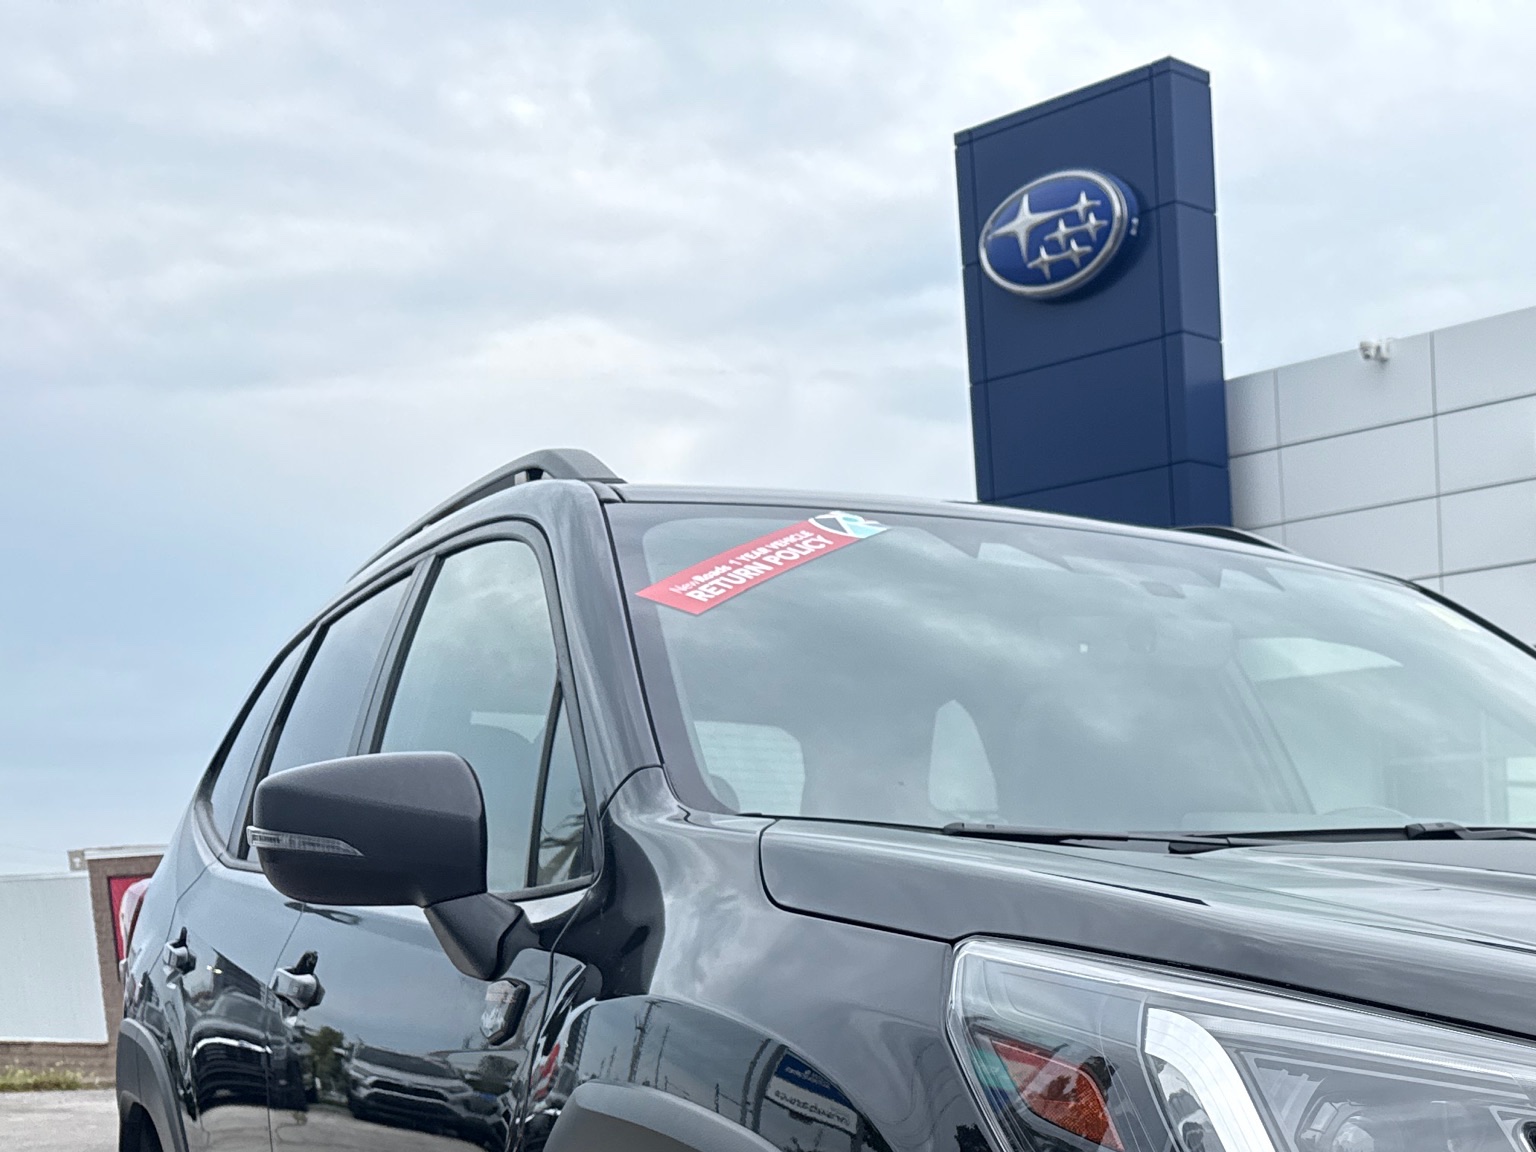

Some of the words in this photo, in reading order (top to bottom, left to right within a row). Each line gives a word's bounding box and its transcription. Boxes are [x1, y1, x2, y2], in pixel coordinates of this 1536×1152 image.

[669, 564, 732, 594] NewRoads
[735, 545, 773, 563] YEAR
[765, 530, 814, 550] VEHICLE
[685, 561, 773, 602] RETURN
[762, 534, 834, 566] POLICY
